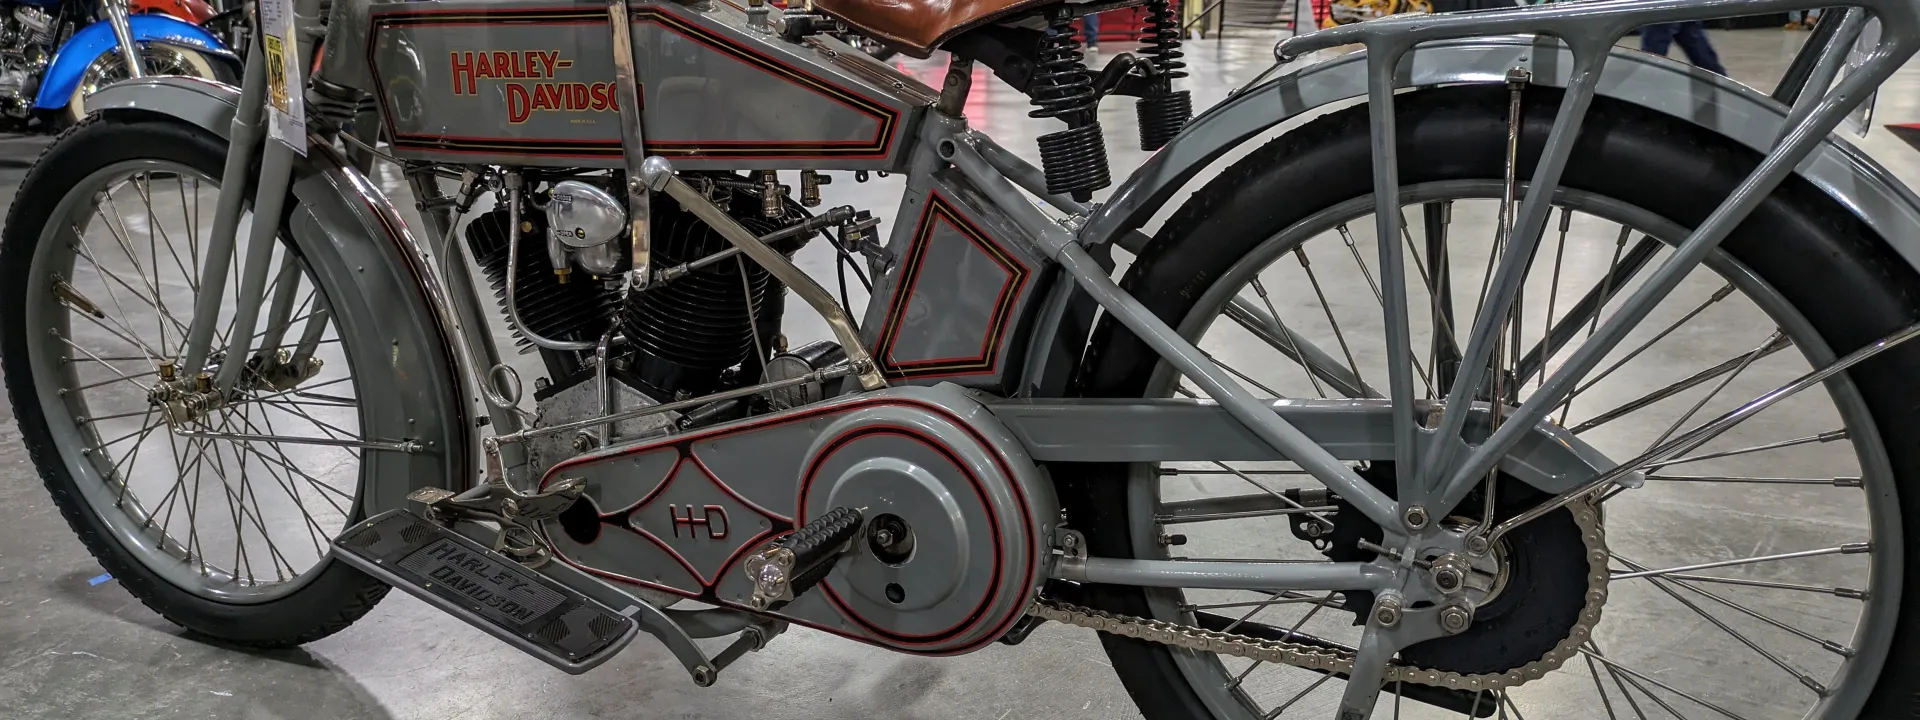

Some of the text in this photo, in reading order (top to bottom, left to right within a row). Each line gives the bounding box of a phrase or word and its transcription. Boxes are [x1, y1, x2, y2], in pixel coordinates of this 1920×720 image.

[450, 50, 574, 96] HARLEY-
[427, 542, 535, 595] HARLEY-
[428, 565, 535, 621] DAVIDSON
